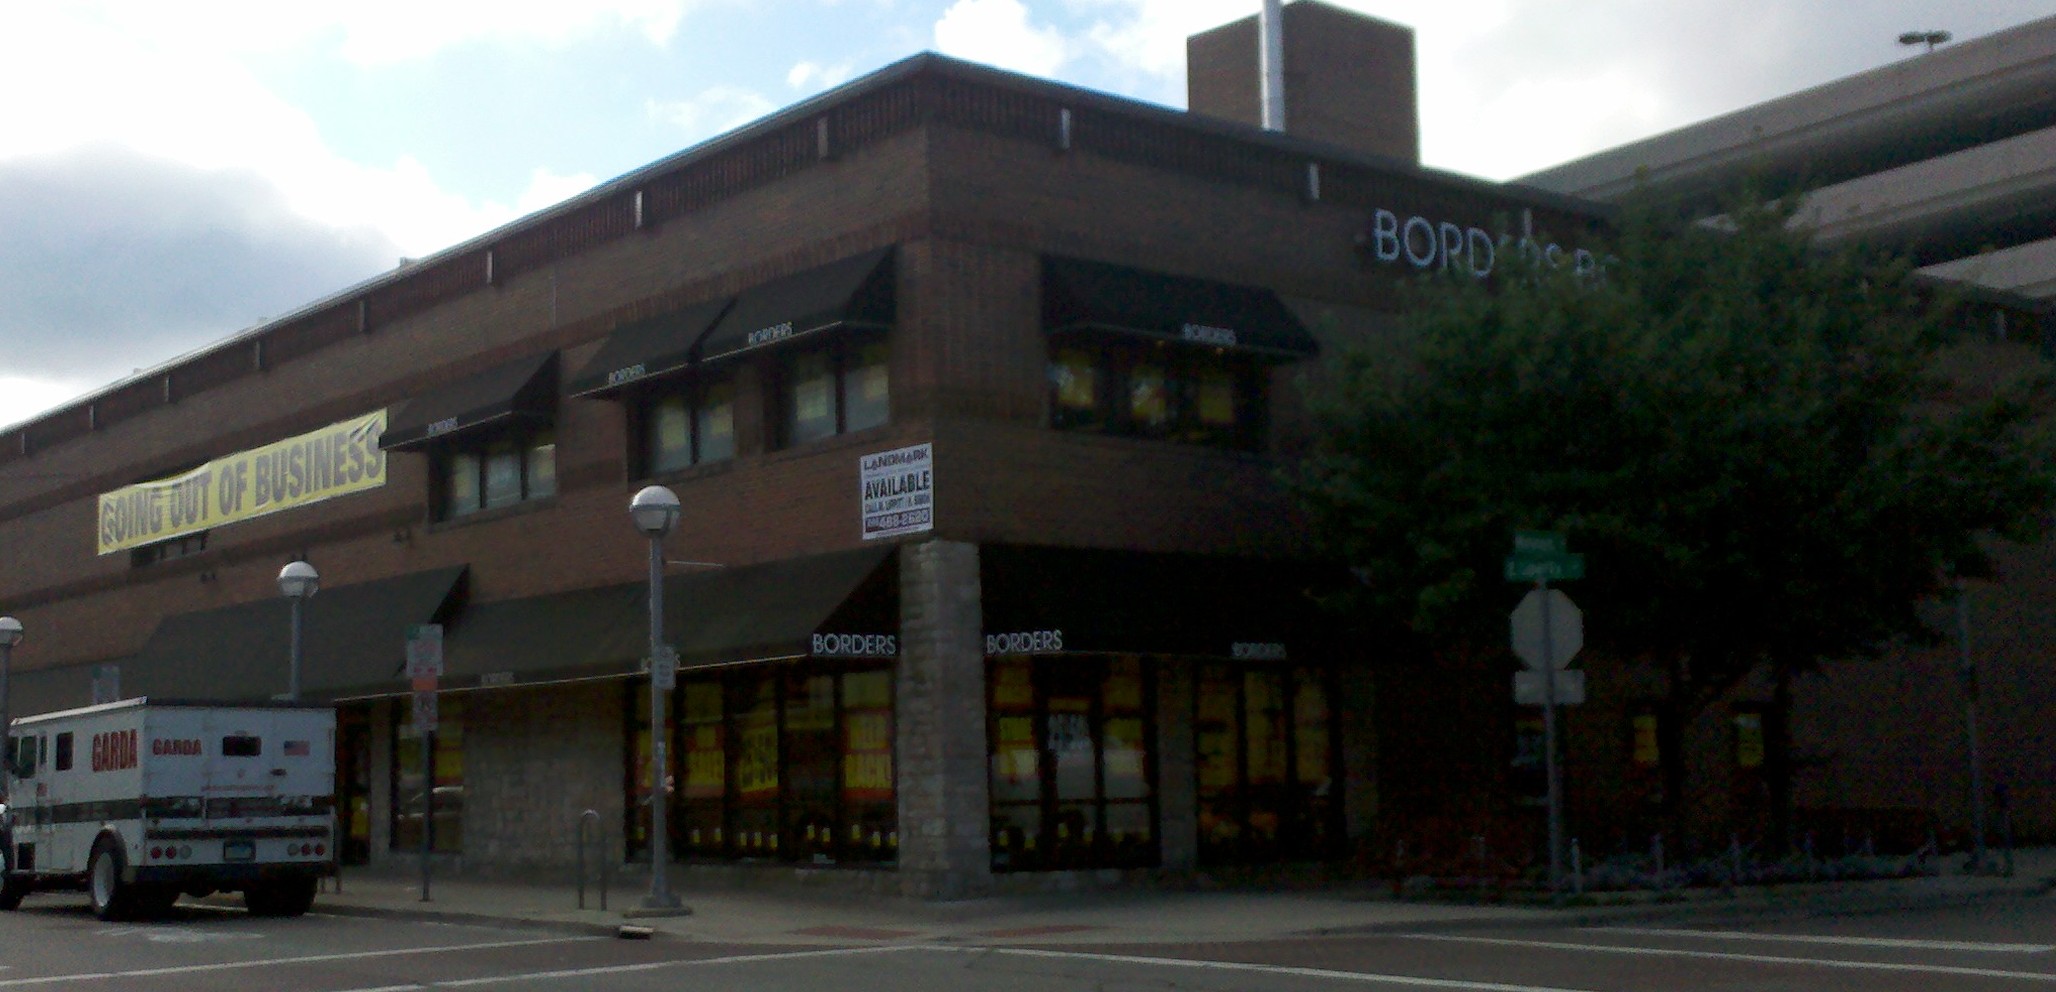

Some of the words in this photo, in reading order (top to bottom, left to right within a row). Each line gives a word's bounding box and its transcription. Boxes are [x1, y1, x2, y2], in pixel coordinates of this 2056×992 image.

[864, 448, 928, 470] LANDMARK
[101, 486, 163, 546] GOING
[170, 470, 212, 529] OUT
[218, 459, 249, 516] OF
[255, 422, 384, 508] BUSINESS
[865, 470, 930, 500] AVAILABLE
[812, 633, 896, 655] BORDERS
[986, 630, 1063, 654] BORDERS
[92, 728, 138, 773] GARDA
[152, 738, 203, 756] GARDA
